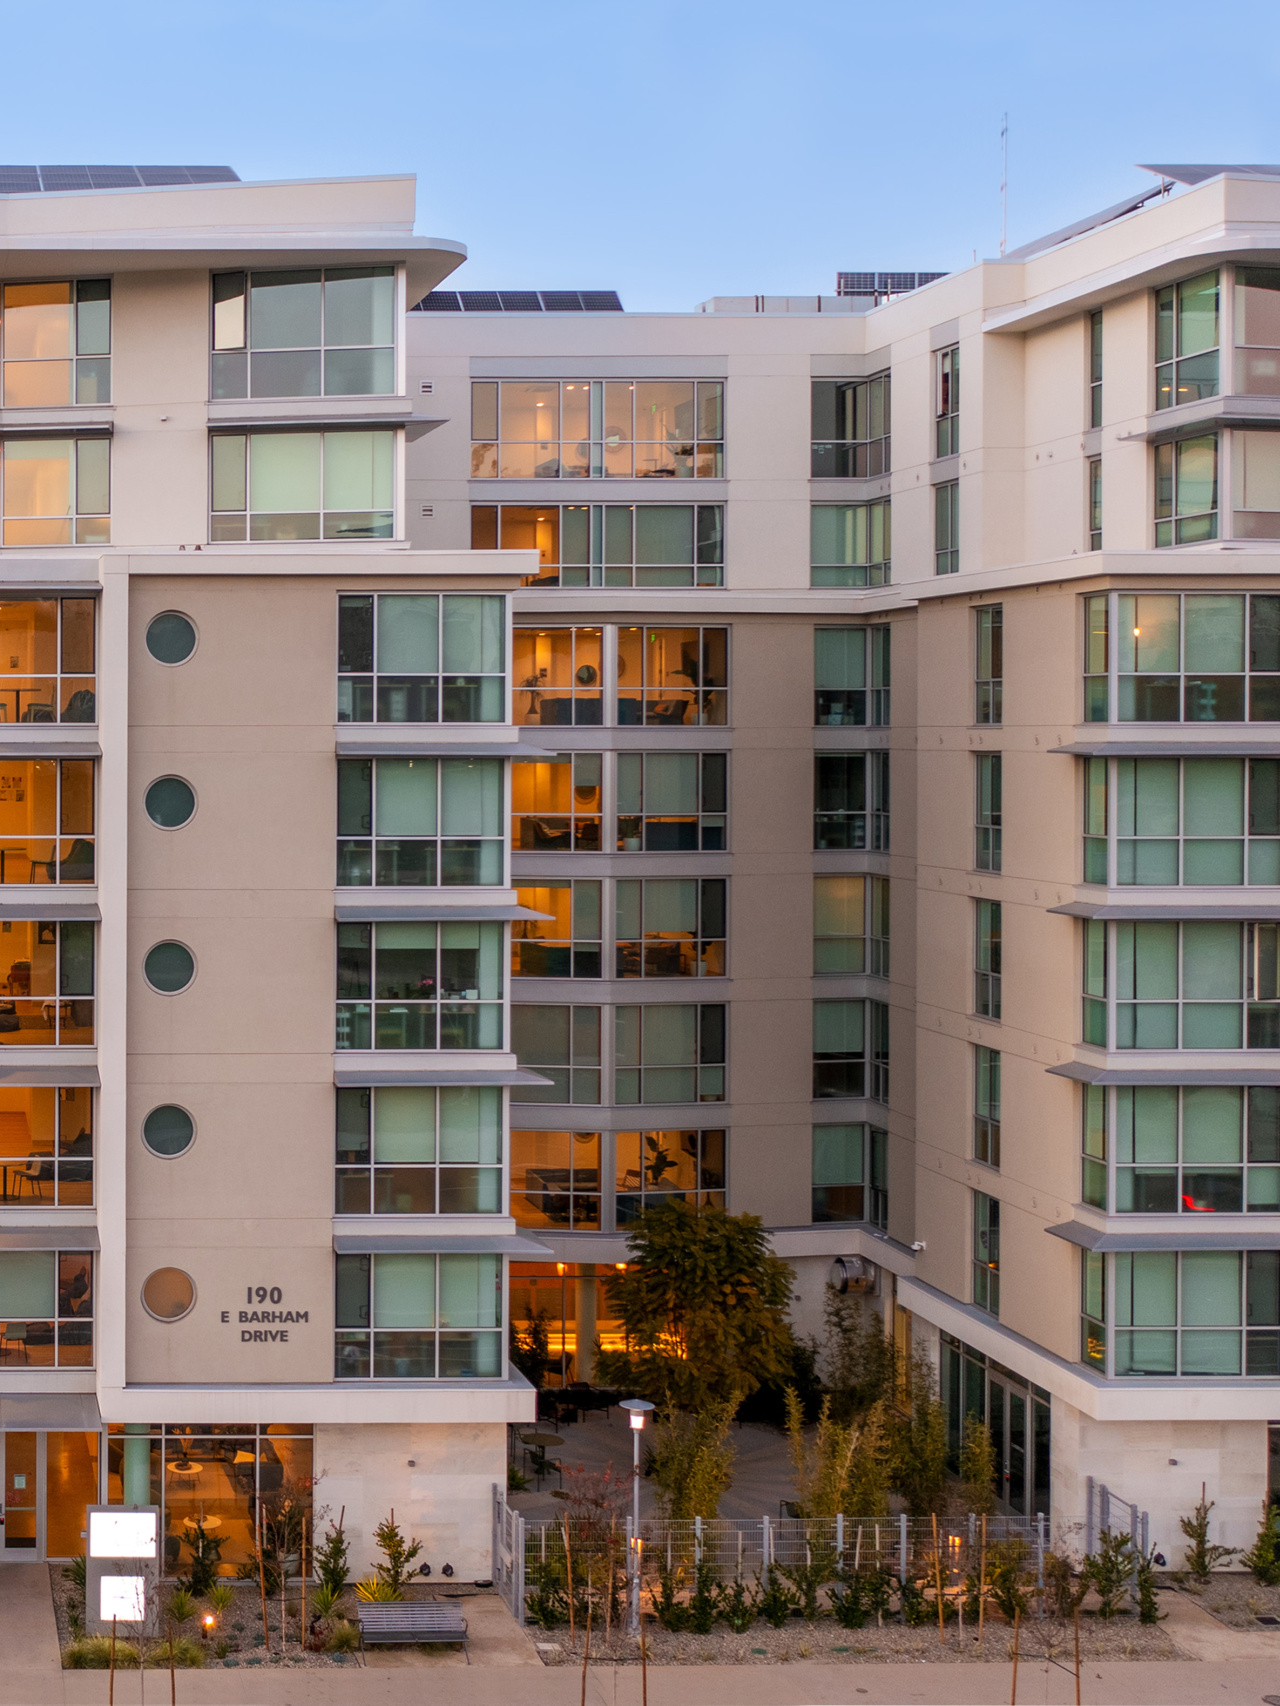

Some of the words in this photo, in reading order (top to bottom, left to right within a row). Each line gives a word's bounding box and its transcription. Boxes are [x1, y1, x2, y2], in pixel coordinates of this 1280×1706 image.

[247, 1287, 282, 1304] 190
[221, 1311, 229, 1323] E
[239, 1311, 308, 1323] BARHAM
[241, 1330, 288, 1342] DRIVE
